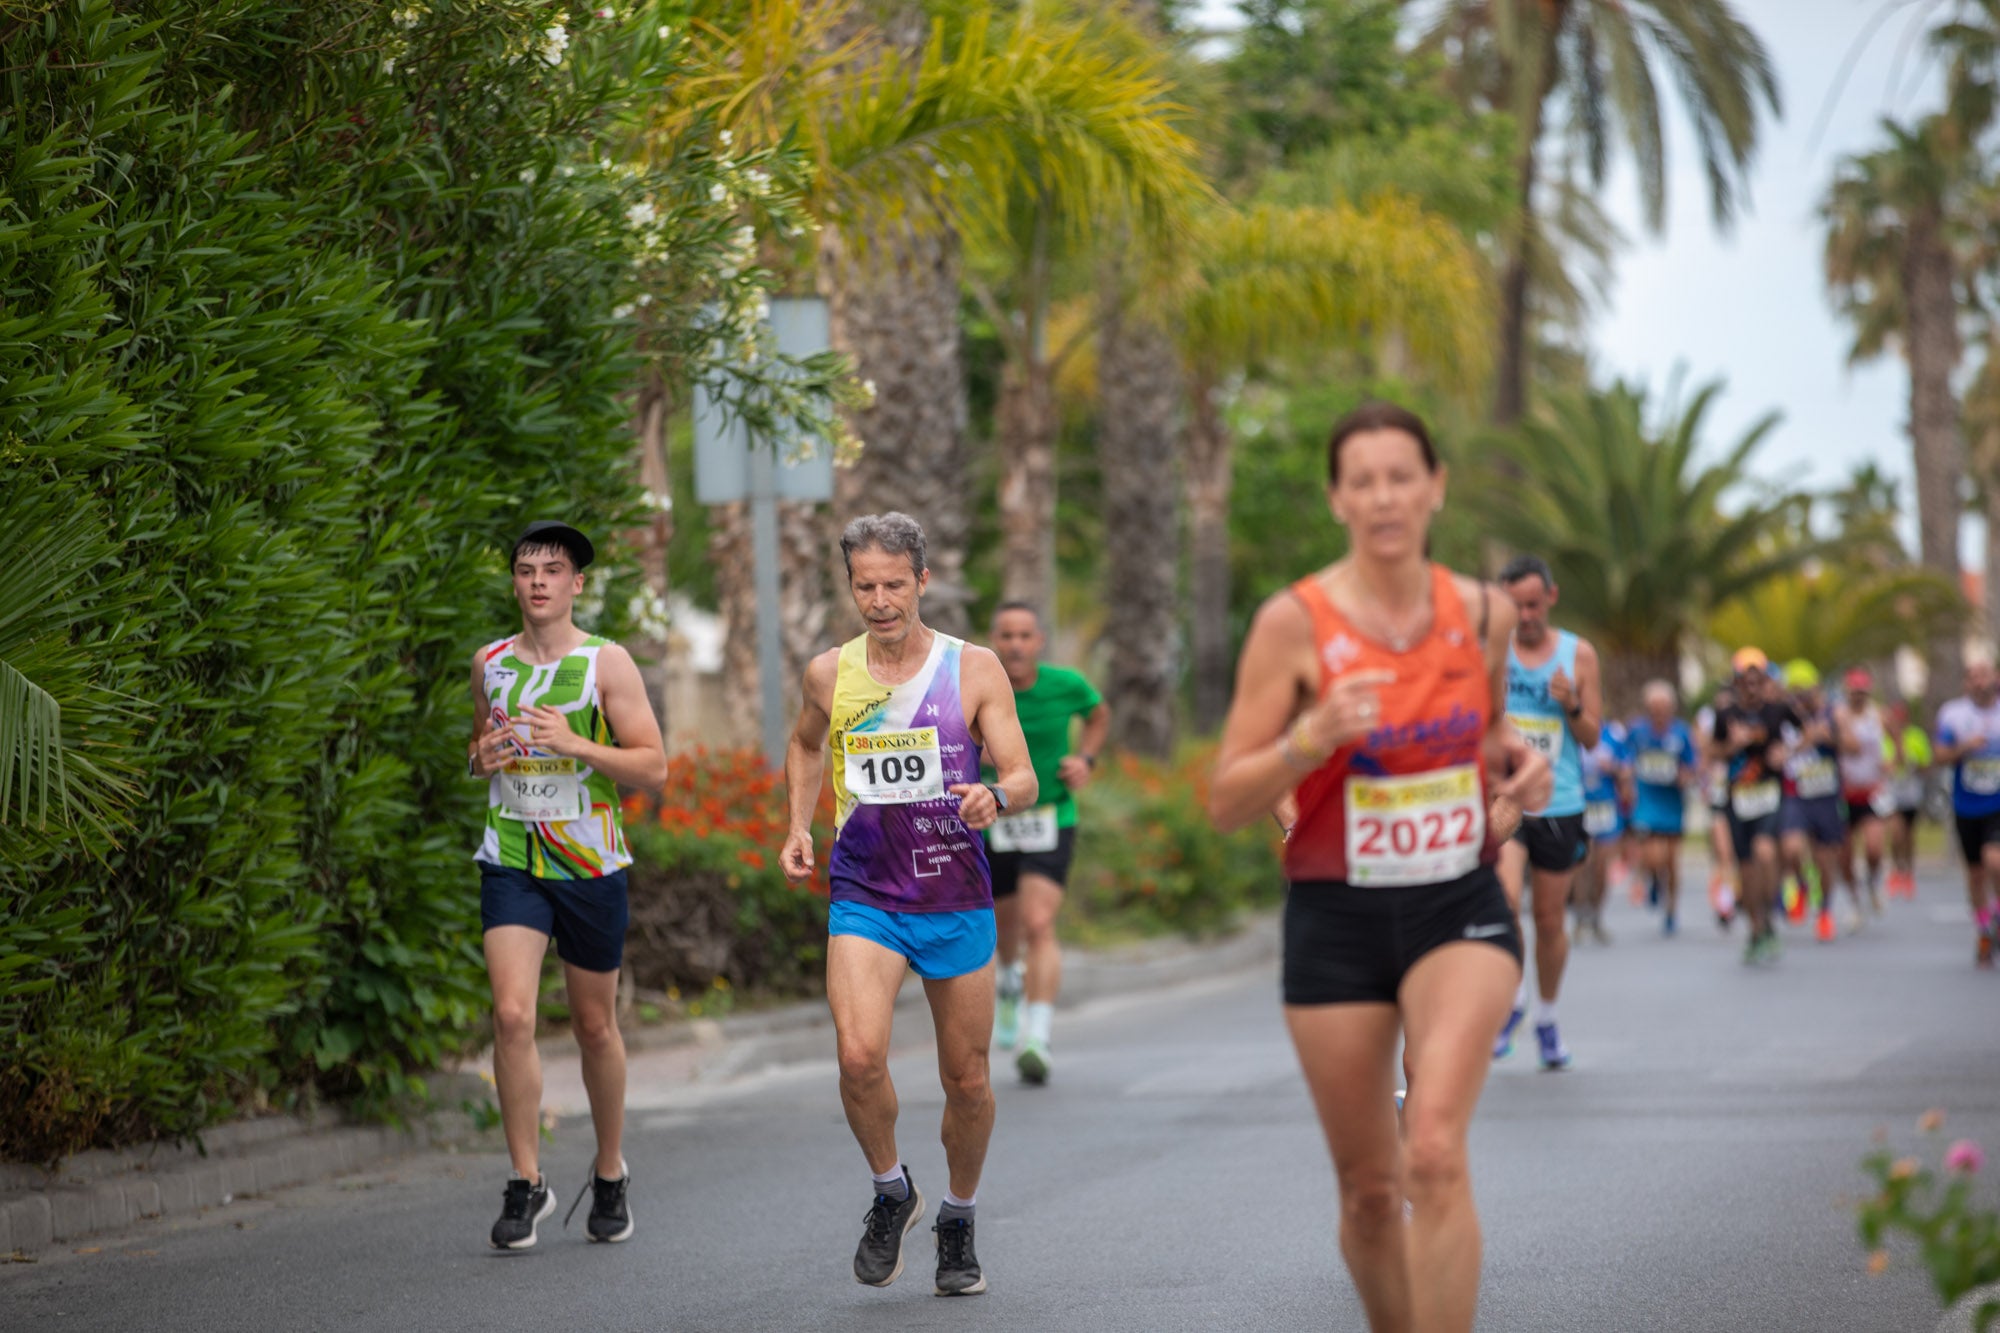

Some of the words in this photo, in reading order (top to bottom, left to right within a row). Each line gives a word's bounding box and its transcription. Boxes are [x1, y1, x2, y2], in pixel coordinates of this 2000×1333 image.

[855, 737, 869, 750] 38
[869, 737, 917, 750] FONDO
[861, 755, 926, 785] 109
[513, 780, 558, 799] 4200
[935, 818, 968, 837] VIDA
[1356, 805, 1478, 857] 2022
